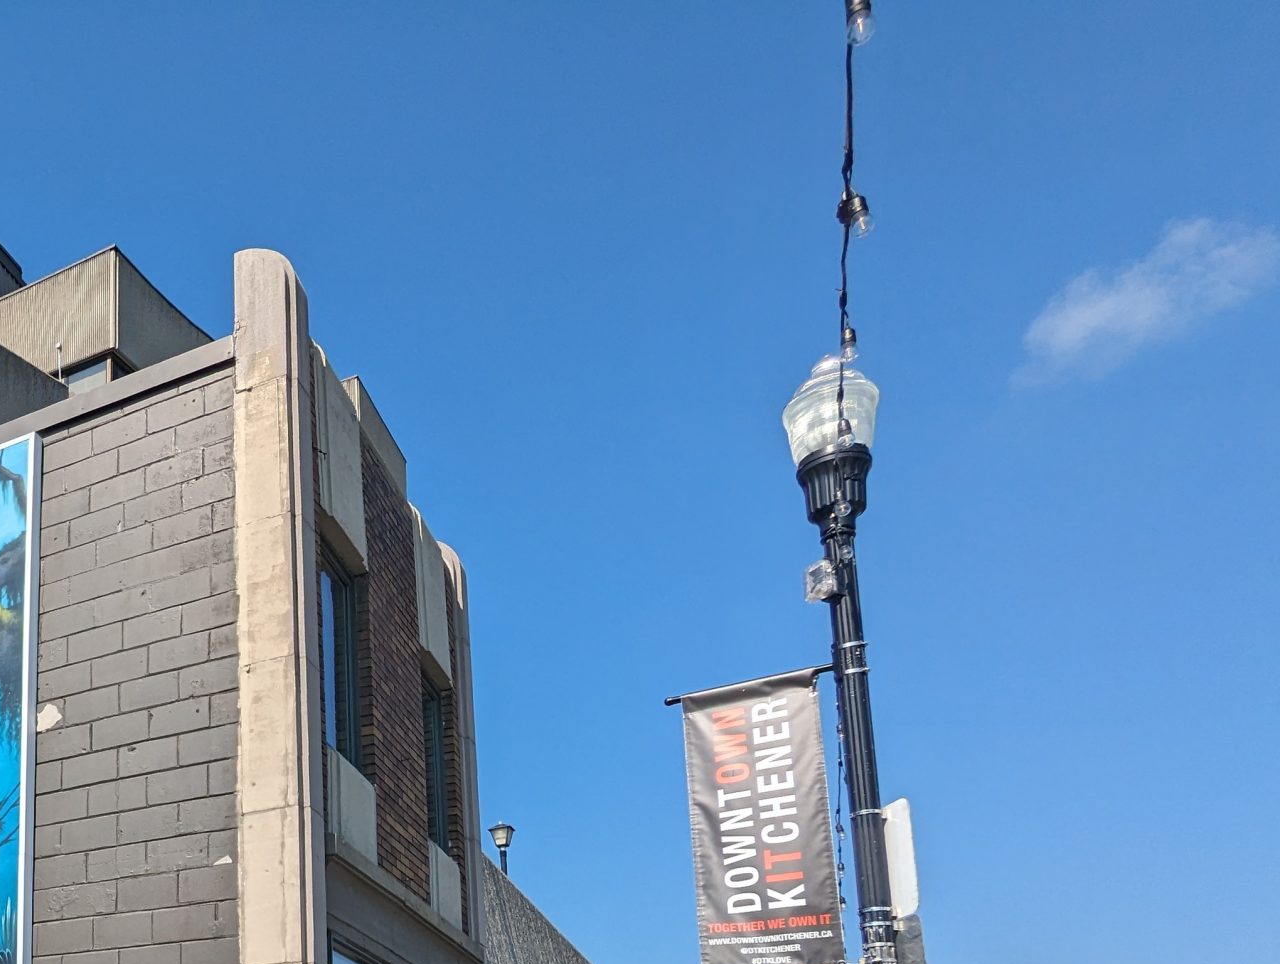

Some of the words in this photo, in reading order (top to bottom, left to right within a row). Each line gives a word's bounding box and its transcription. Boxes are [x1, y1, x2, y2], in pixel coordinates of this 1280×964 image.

[711, 706, 763, 916] DOWNTOWN
[751, 697, 807, 910] KITCHENER
[708, 920, 766, 933] TOGETHER
[767, 918, 786, 930] WE
[789, 915, 817, 928] OWN
[820, 914, 832, 925] IT
[708, 930, 833, 946] WWW.DOWNTOWNKITCHENER.CA
[740, 944, 801, 955] @DTKITCHENER
